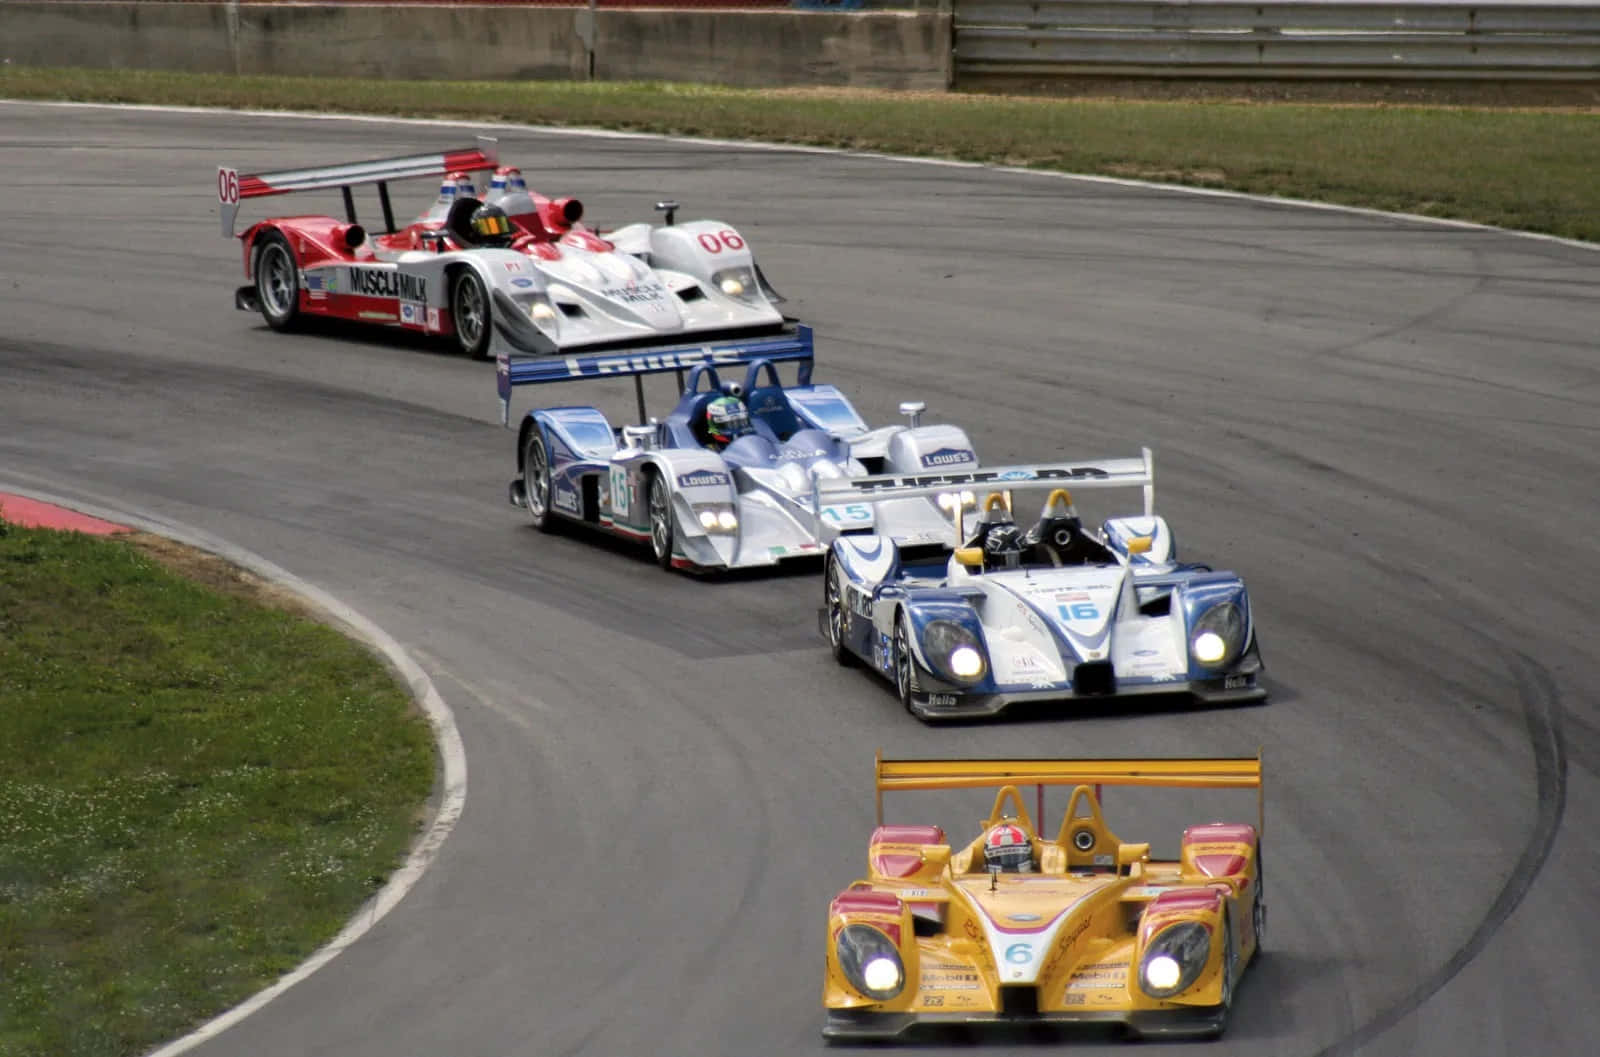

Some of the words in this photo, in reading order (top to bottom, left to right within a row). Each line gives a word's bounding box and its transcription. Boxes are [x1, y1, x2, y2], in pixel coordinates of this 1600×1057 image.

[218, 168, 239, 202] 06
[697, 230, 744, 254] 06
[350, 267, 399, 297] MUSCLE
[400, 273, 427, 302] MILK
[820, 505, 870, 521] 15
[1057, 603, 1099, 621] 16
[1005, 943, 1032, 965] 6
